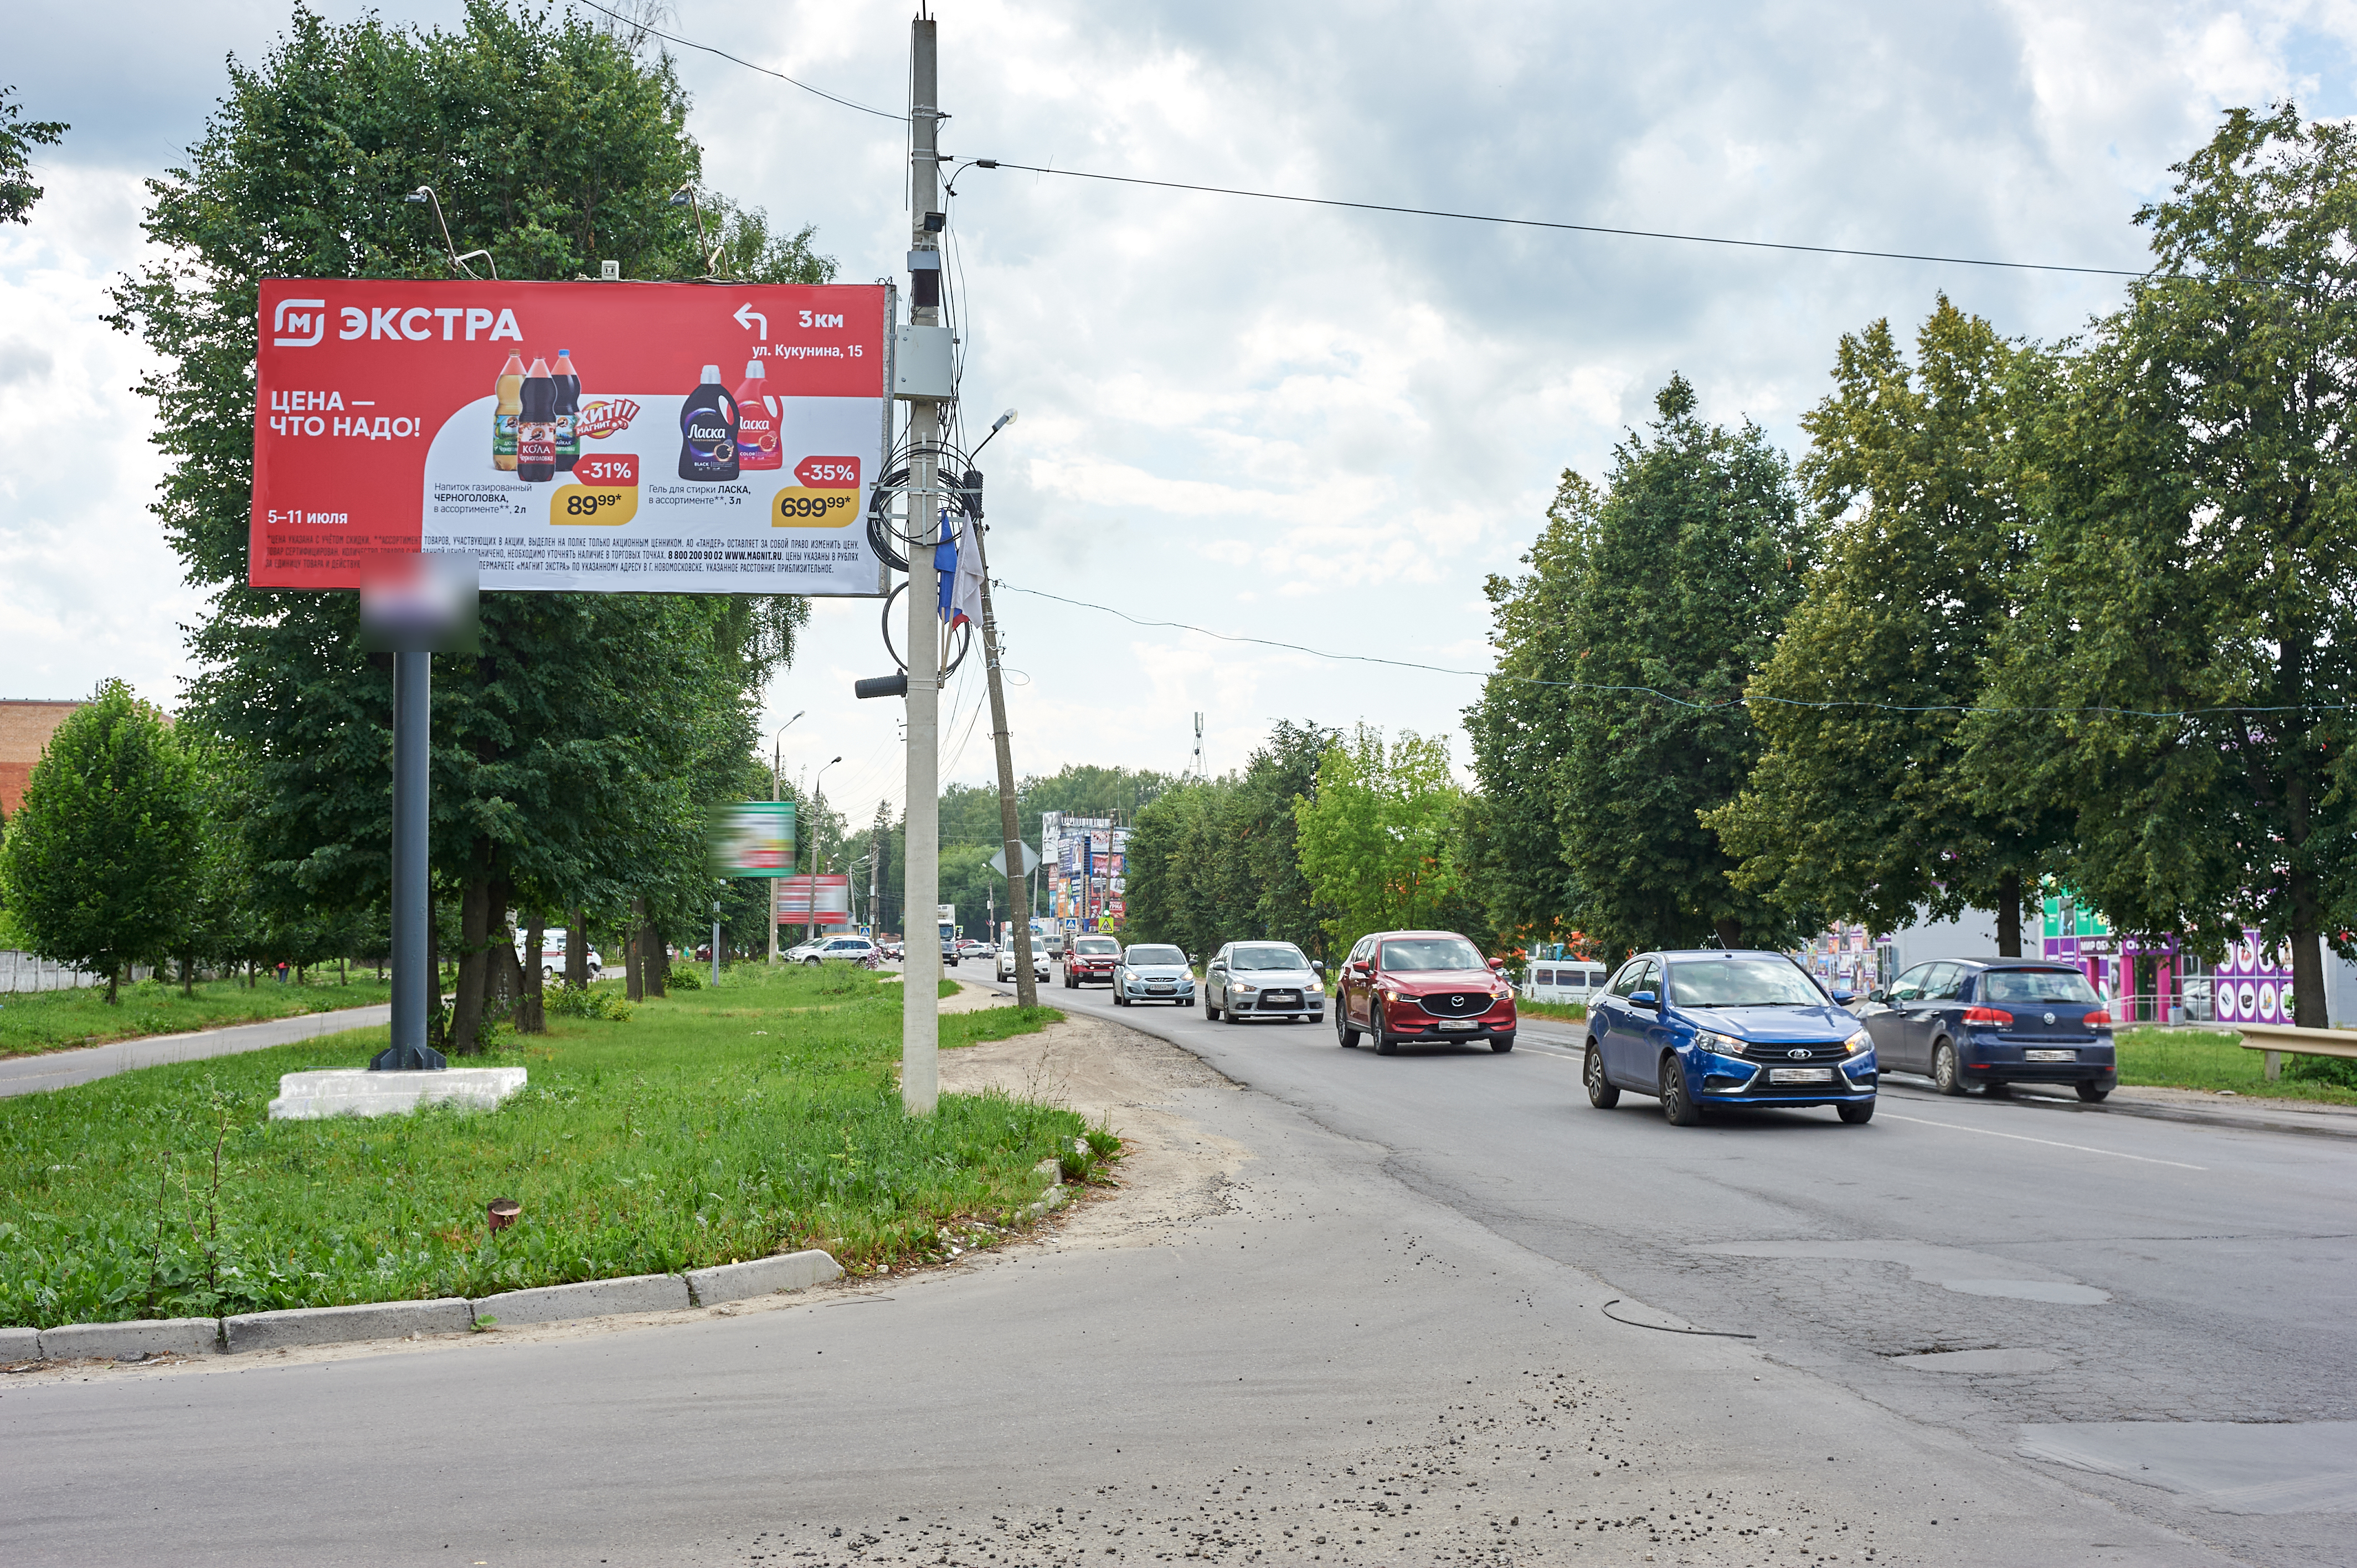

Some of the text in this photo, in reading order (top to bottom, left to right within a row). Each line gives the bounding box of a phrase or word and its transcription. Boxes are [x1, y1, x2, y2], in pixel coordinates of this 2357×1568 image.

[339, 307, 523, 341] ЭКСТРА
[799, 311, 843, 327] 3 км
[753, 344, 862, 359] ул. Кукунина, 15
[271, 391, 344, 414] ЦЕНА
[270, 416, 420, 440] ЧТО НАДО!
[577, 420, 610, 434] МАГНИТ
[688, 424, 725, 439] Ласка
[522, 444, 550, 454] КОЛА
[519, 454, 553, 463] Черноголовка
[583, 463, 631, 478] -31%
[802, 465, 854, 481] -35%
[472, 484, 532, 493] газированный
[687, 487, 716, 495] стирки
[718, 486, 750, 494] ЛАСКА,
[435, 494, 508, 503] ЧЕРНОГОЛОВКА,
[307, 513, 347, 523] июля
[289, 535, 313, 544] УКАЗАНА
[425, 537, 450, 545] ТОВАРОВ,
[454, 537, 496, 546] УЧАСТВУЮЩИХ
[499, 537, 502, 545] В
[505, 538, 526, 546] АКЦИИ,
[529, 538, 555, 547] ВЫДЕЛЕН
[568, 538, 586, 546] ПОЛКЕ
[589, 538, 610, 546] ТОЛЬКО
[613, 539, 648, 548] АКЦИОННЫМ
[651, 539, 683, 548] ЦЕННИКОМ.
[686, 539, 693, 547] АО
[696, 539, 724, 549] «ТАНДЕР»
[728, 539, 758, 548] ОСТАВЛЯЕТ
[770, 538, 788, 548] СОБОЙ
[791, 540, 808, 548] ПРАВО
[811, 540, 840, 549] ИЗМЕНИТЬ
[843, 540, 858, 550] ЦЕНУ.
[508, 549, 545, 559] НЕОБХОДИМО
[548, 550, 575, 558] УТОЧНЯТЬ
[578, 550, 604, 559] НАЛИЧИЕ
[606, 550, 609, 559] В
[612, 550, 640, 559] ТОРГОВЫХ
[675, 551, 687, 559] 800
[689, 551, 702, 559] 200
[725, 551, 783, 560] WWW.MAGNIT.RU.
[786, 552, 801, 561] ЦЕНЫ
[804, 552, 829, 560] УКАЗАНЫ
[838, 553, 858, 561] РУБЛЯХ
[479, 561, 514, 570] ПЕРМАРКЕТЕ
[545, 562, 570, 570] ЭКСТРА»
[573, 563, 579, 571] ПО
[582, 563, 618, 571] УКАЗАННОМУ
[620, 563, 641, 572] АДРЕСУ
[655, 563, 703, 571] НОВОМОСКОВСКЕ.
[707, 564, 738, 572] УКАЗАННОЕ
[740, 564, 775, 572] РАССТОЯНИЕ
[778, 564, 833, 572] ПРИБЛИЗИТЕЛЬНОЕ.
